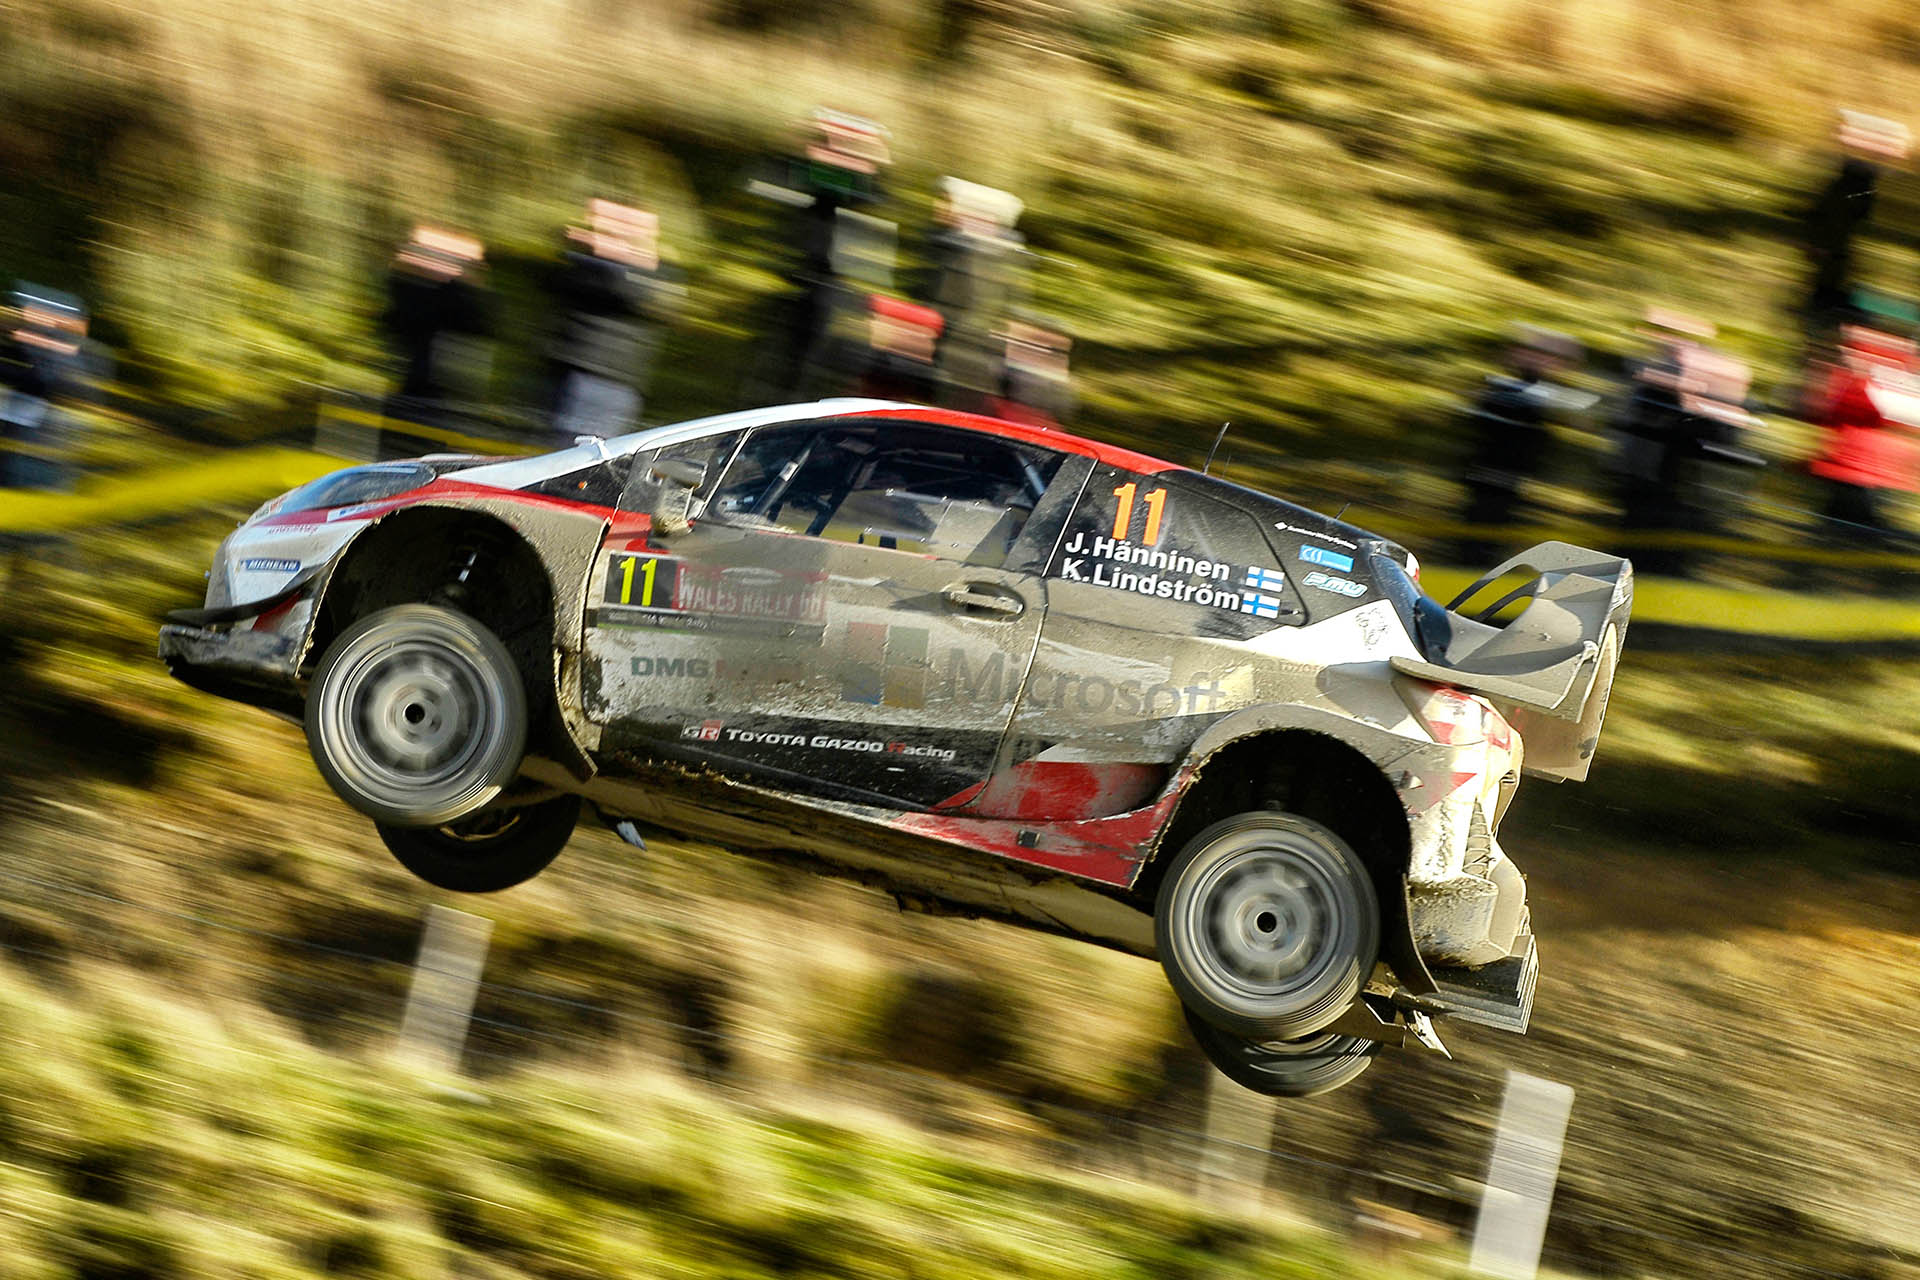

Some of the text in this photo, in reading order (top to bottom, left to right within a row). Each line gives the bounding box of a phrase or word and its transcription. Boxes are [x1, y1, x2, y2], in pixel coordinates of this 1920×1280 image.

[1112, 482, 1168, 547] 11
[247, 559, 300, 572] MICHELIN
[619, 556, 658, 607] 11
[678, 567, 736, 613] WALES
[741, 591, 794, 617] RALLY
[630, 656, 710, 679] DMG
[949, 649, 1227, 718] Microsoft
[725, 728, 806, 747] TOYOTA
[809, 735, 885, 753] GAZOO
[887, 741, 958, 762] Racing
